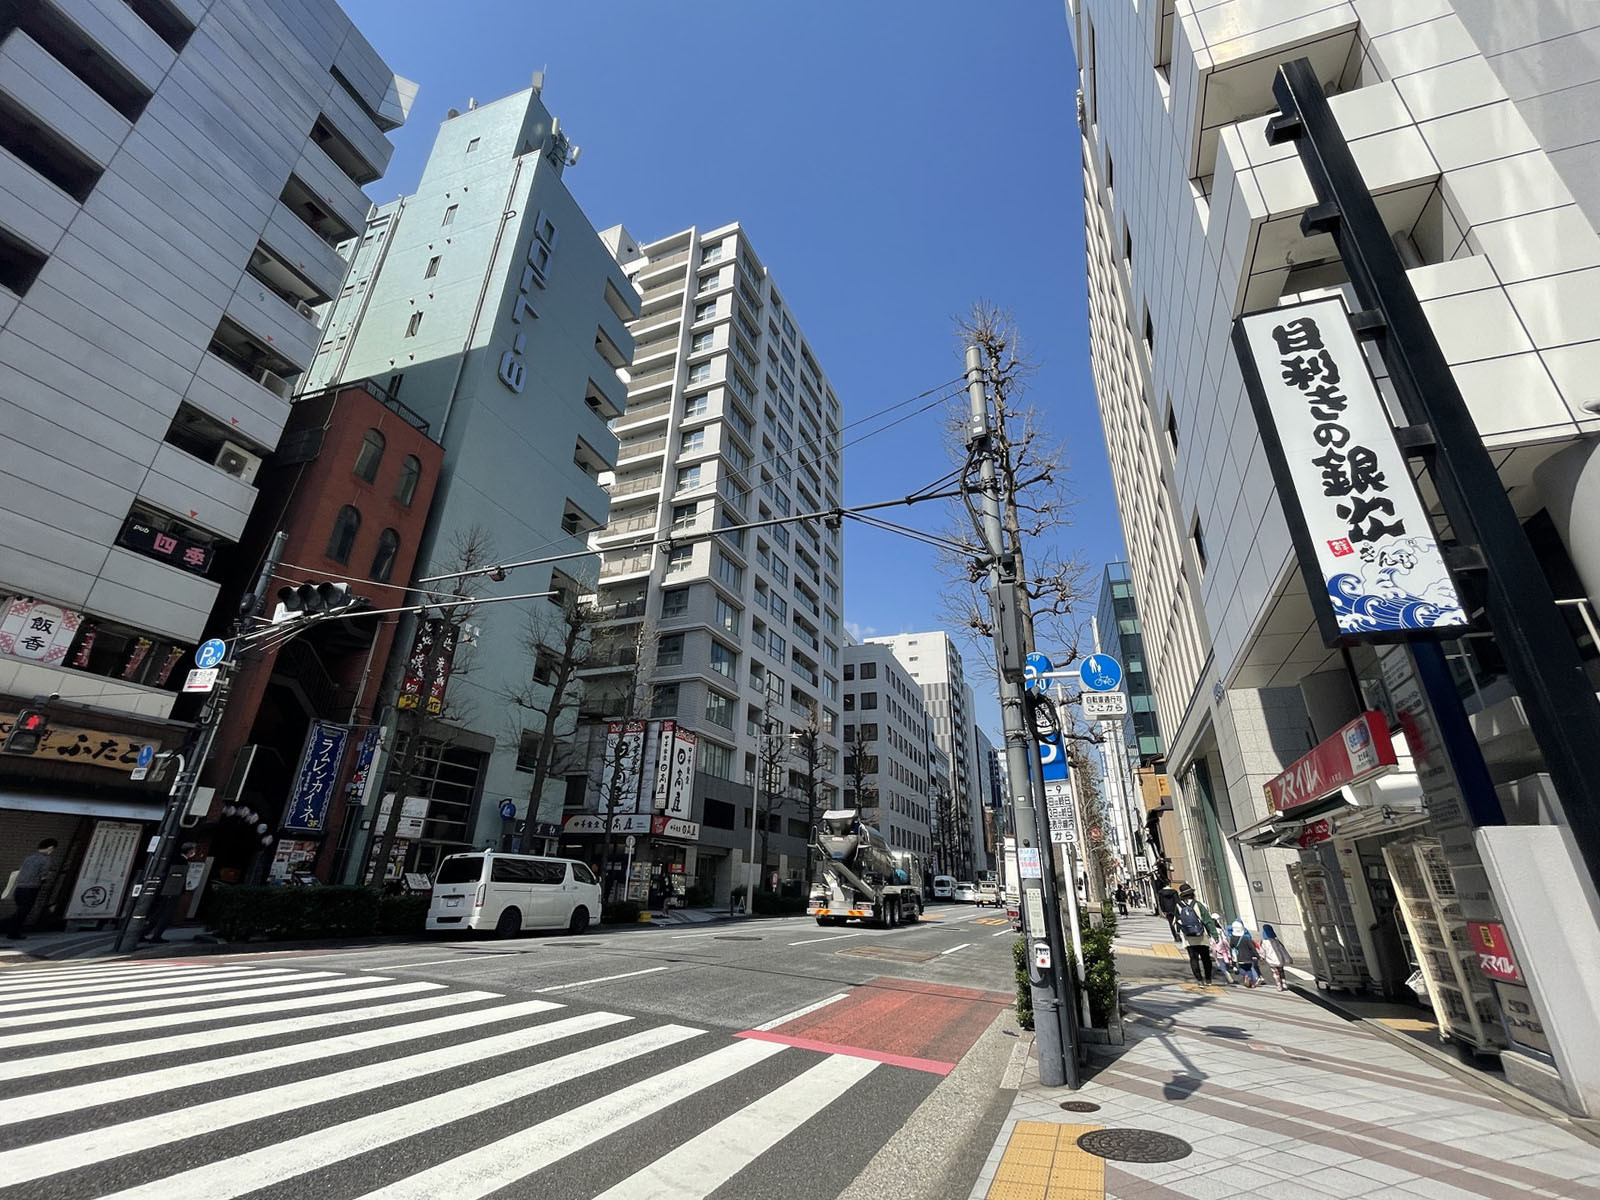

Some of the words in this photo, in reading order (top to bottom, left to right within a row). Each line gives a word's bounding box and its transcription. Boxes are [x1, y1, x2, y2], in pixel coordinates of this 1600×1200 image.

[1272, 316, 1406, 544] 目利きの銀次
[133, 524, 150, 534] pub
[153, 532, 206, 566] 四季
[21, 616, 55, 651] 飯香
[199, 646, 215, 665] P
[1087, 704, 1123, 712] ここから
[299, 739, 334, 822] ラムレンカイネ
[1276, 759, 1319, 808] スマイル
[1054, 831, 1074, 841] から
[1479, 953, 1515, 974] スマイル
